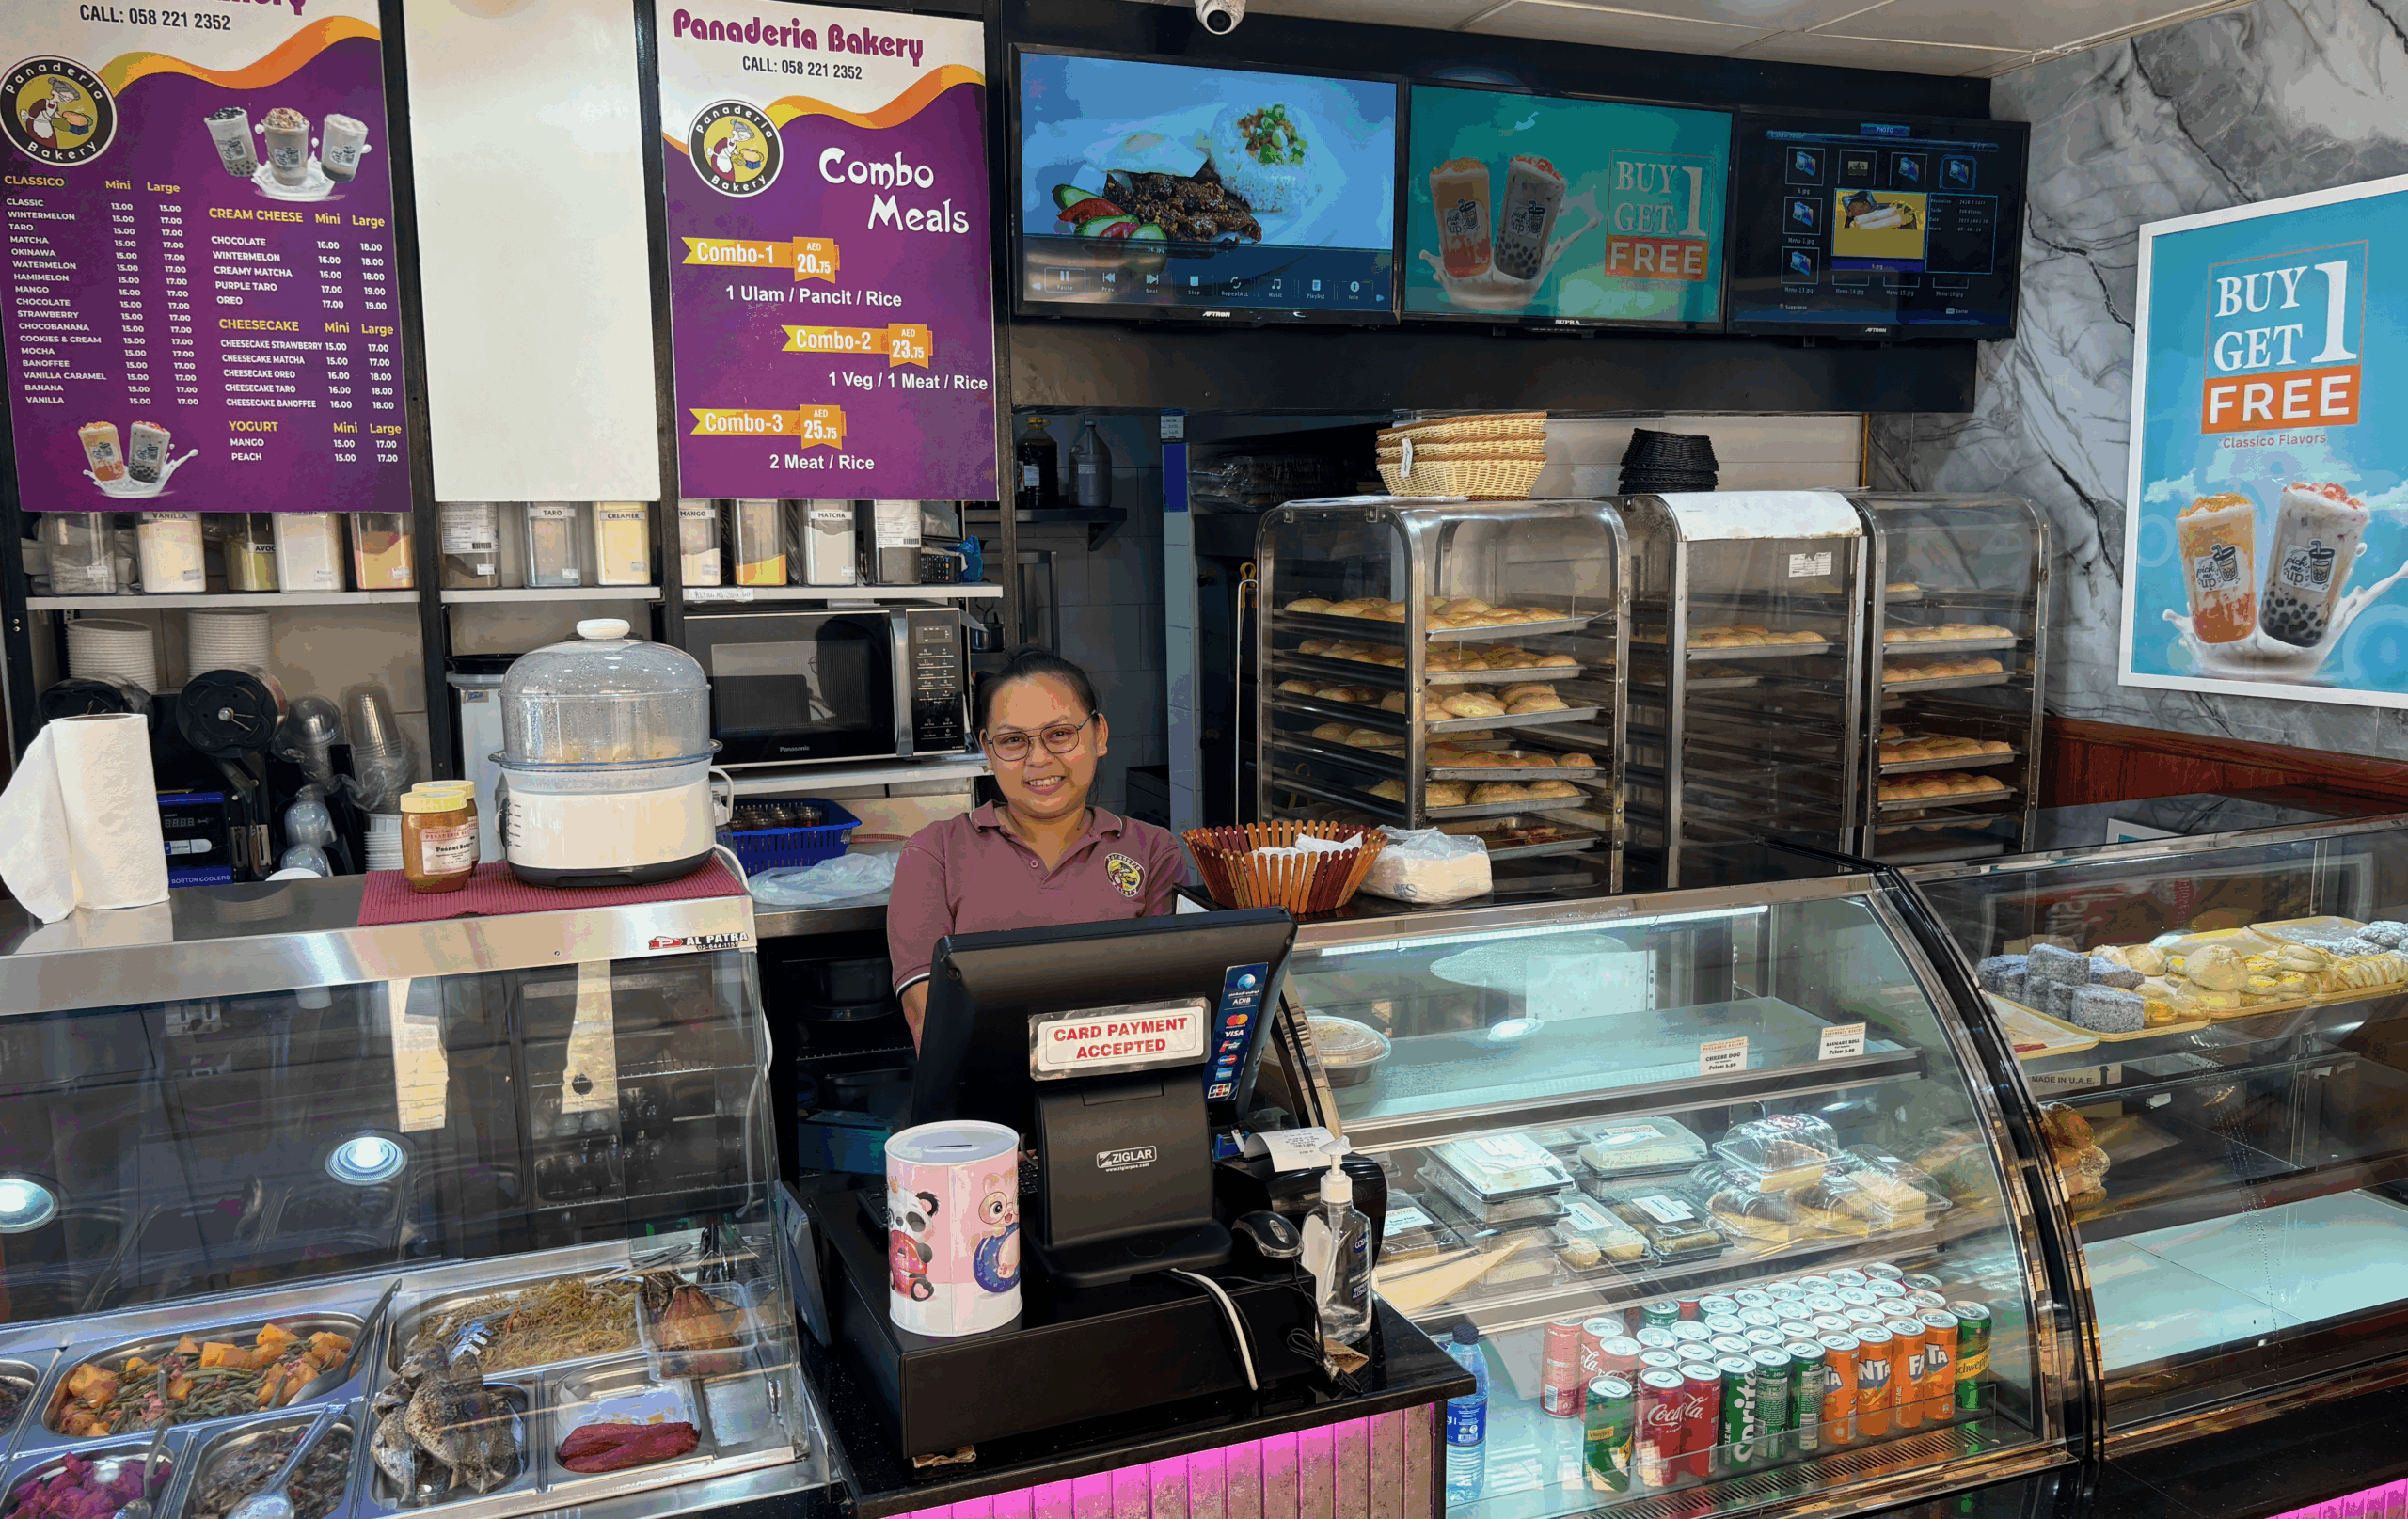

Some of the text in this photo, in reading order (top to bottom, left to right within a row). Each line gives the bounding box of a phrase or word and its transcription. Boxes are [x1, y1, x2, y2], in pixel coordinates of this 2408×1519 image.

[79, 4, 231, 31] CALL: 058 221 2352
[673, 8, 924, 67] Panaderia Bakery
[742, 55, 863, 80] CALL: 058 221 2352
[6, 60, 104, 102] Panaderia
[695, 104, 773, 140] Panaderia
[26, 139, 99, 162] Bakery
[818, 147, 934, 190] Combo
[4, 175, 181, 194] CLASSICO Mini Large
[711, 174, 767, 193] Bakery
[1614, 160, 1679, 195] BUY
[6, 198, 182, 213] CLASSIC 13.00 15.00
[1613, 166, 1706, 237] GET 1
[8, 211, 182, 225] WINTERMELON 15.00 17.00
[209, 207, 386, 229] CREAM CHEESE Mini Large
[867, 193, 970, 234] Meals
[8, 223, 34, 231] TARO
[9, 236, 50, 245] MATCHA
[211, 235, 267, 246] CHOCOLATE
[10, 248, 56, 258] OKINAWA
[212, 250, 281, 262] WINTERMELON
[696, 242, 832, 275] Combo-1 AED 20.75
[1609, 241, 1703, 275] FREE
[12, 261, 77, 270] WATERMELON
[214, 265, 293, 277] CREAMY MATCHA
[13, 273, 70, 282] HAMIMELON
[14, 285, 50, 294] MANGO
[214, 281, 277, 292] PURPLE TARO
[16, 297, 71, 307] CHOCOLATE
[216, 295, 244, 306] OREO
[726, 285, 903, 308] 1 Ulam Pancit Rice
[17, 309, 79, 319] STRAWBERRY
[2214, 260, 2357, 364] BUY 1
[18, 323, 90, 331] CHOCOBANANA
[218, 318, 394, 337] CHEESECAKE Mini Large
[20, 335, 102, 344] COOKIES & CREAM
[220, 339, 323, 351] CHEESECAKE STRAWBERRY
[796, 328, 925, 359] Combo-2 AED 23.75
[2213, 323, 2303, 372] GET
[22, 359, 71, 368] BANOFFEE
[221, 355, 306, 365] CHEESECAKE MATCHA
[24, 372, 62, 380] VANILLA
[223, 369, 296, 379] CHEESECAKE OREO
[829, 371, 989, 390] 1 Veg 1 Meat Rice
[224, 384, 296, 393] CHEESECAKE TARO
[25, 396, 65, 404] VANILLA
[226, 398, 317, 408] CHEESECAKE BANOFFEE
[2210, 374, 2351, 424] FREE
[229, 420, 402, 436] YOGURT Mini Large
[705, 408, 837, 441] Combo-3 AED 25.75
[230, 438, 264, 447] MANGO
[2223, 434, 2326, 450] Classico Flavors
[231, 452, 262, 461] PEACH
[769, 454, 875, 470] 2 Meat Rice
[151, 512, 188, 520] VANILLA
[255, 545, 276, 553] AVOC
[2284, 556, 2307, 571] pick
[2287, 571, 2304, 585] up
[780, 744, 810, 752] Panasonic
[686, 932, 749, 945] AL PATRA
[1231, 997, 1251, 1005] ADIB
[1054, 1017, 1187, 1042] CARD PAYMENT
[1225, 1029, 1244, 1037] VISA
[1076, 1038, 1166, 1059] ACCEPTED
[1705, 1052, 1728, 1062] CHEESE
[2031, 1075, 2096, 1084] MADE IN U.A.E.
[1112, 1148, 1153, 1163] ZIGLAR
[1859, 1359, 1891, 1381] NTA
